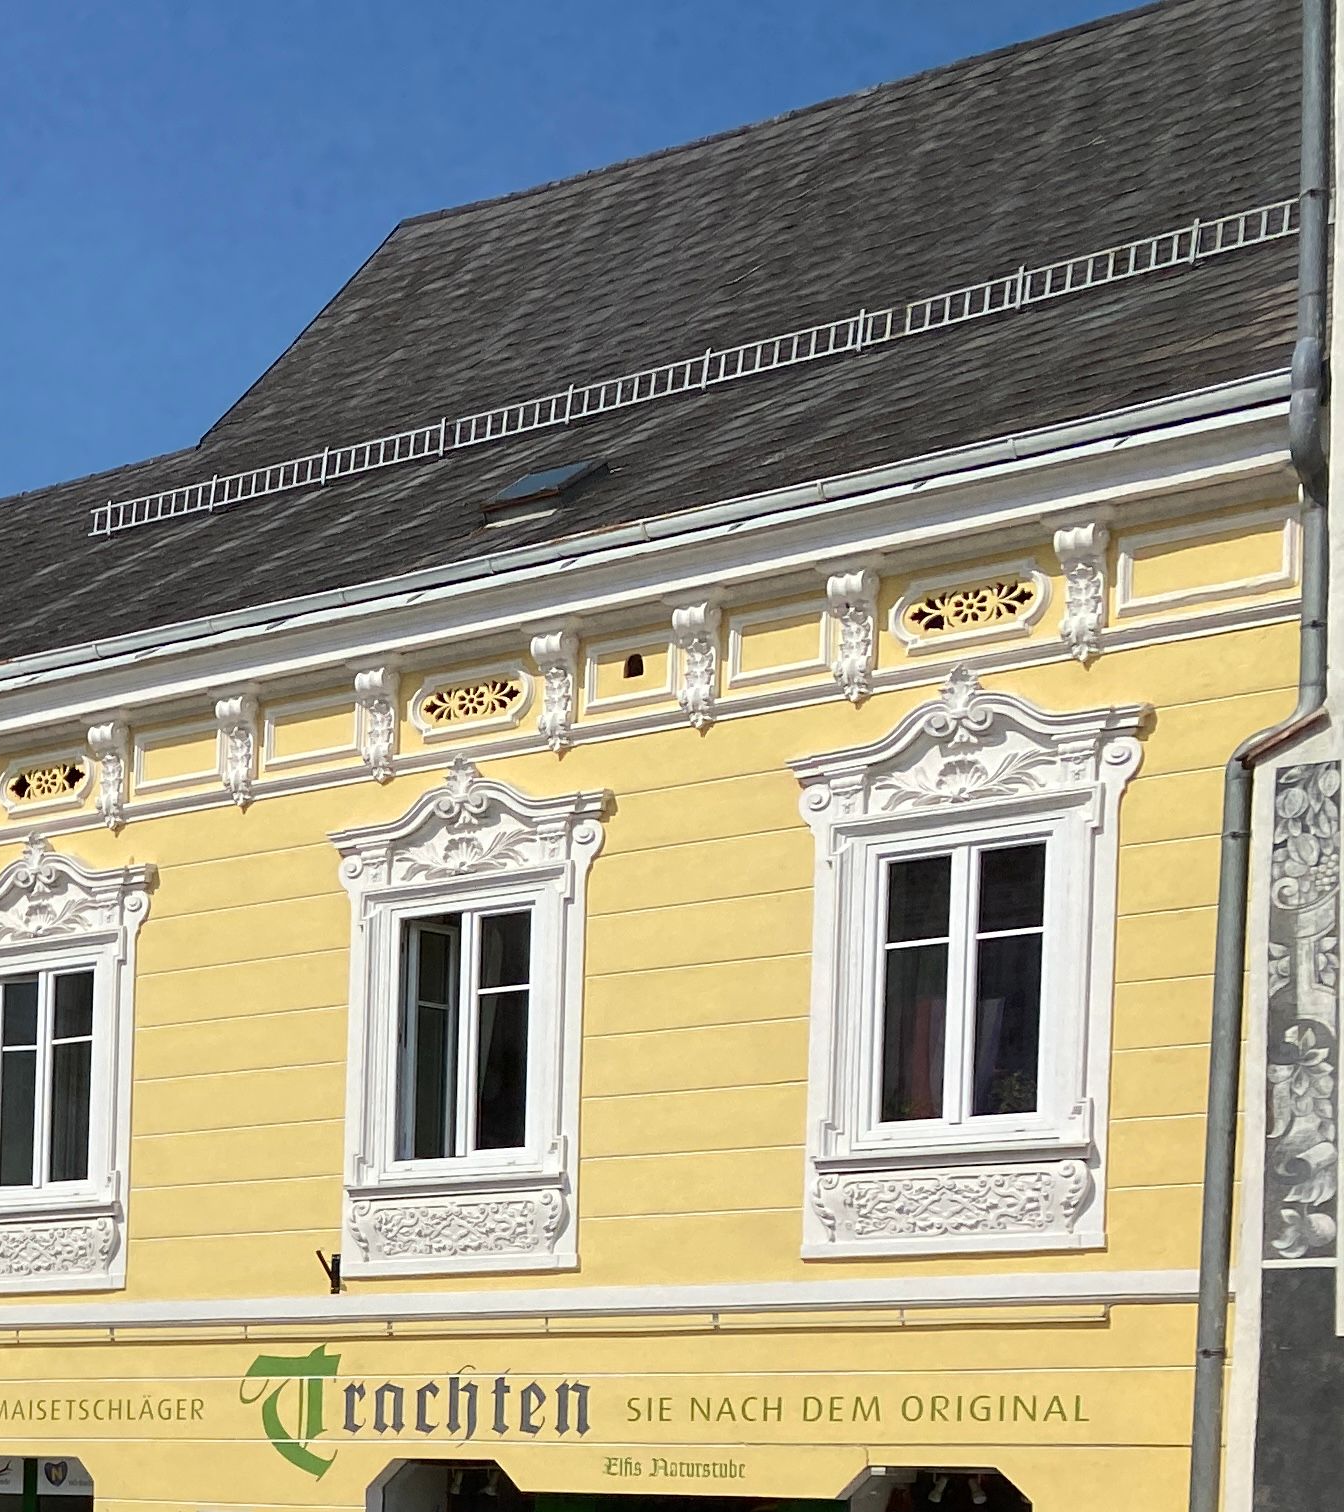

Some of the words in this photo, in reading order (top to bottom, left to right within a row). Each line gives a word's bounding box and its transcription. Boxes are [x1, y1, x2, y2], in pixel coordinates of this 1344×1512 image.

[240, 1343, 590, 1481] Trachten
[626, 1396, 673, 1422] SIE
[689, 1396, 783, 1423] NACH
[802, 1396, 882, 1422] DEM
[901, 1394, 1091, 1423] ORIGINAL
[603, 1456, 642, 1478] Elfis
[648, 1456, 746, 1479] Naturstube
